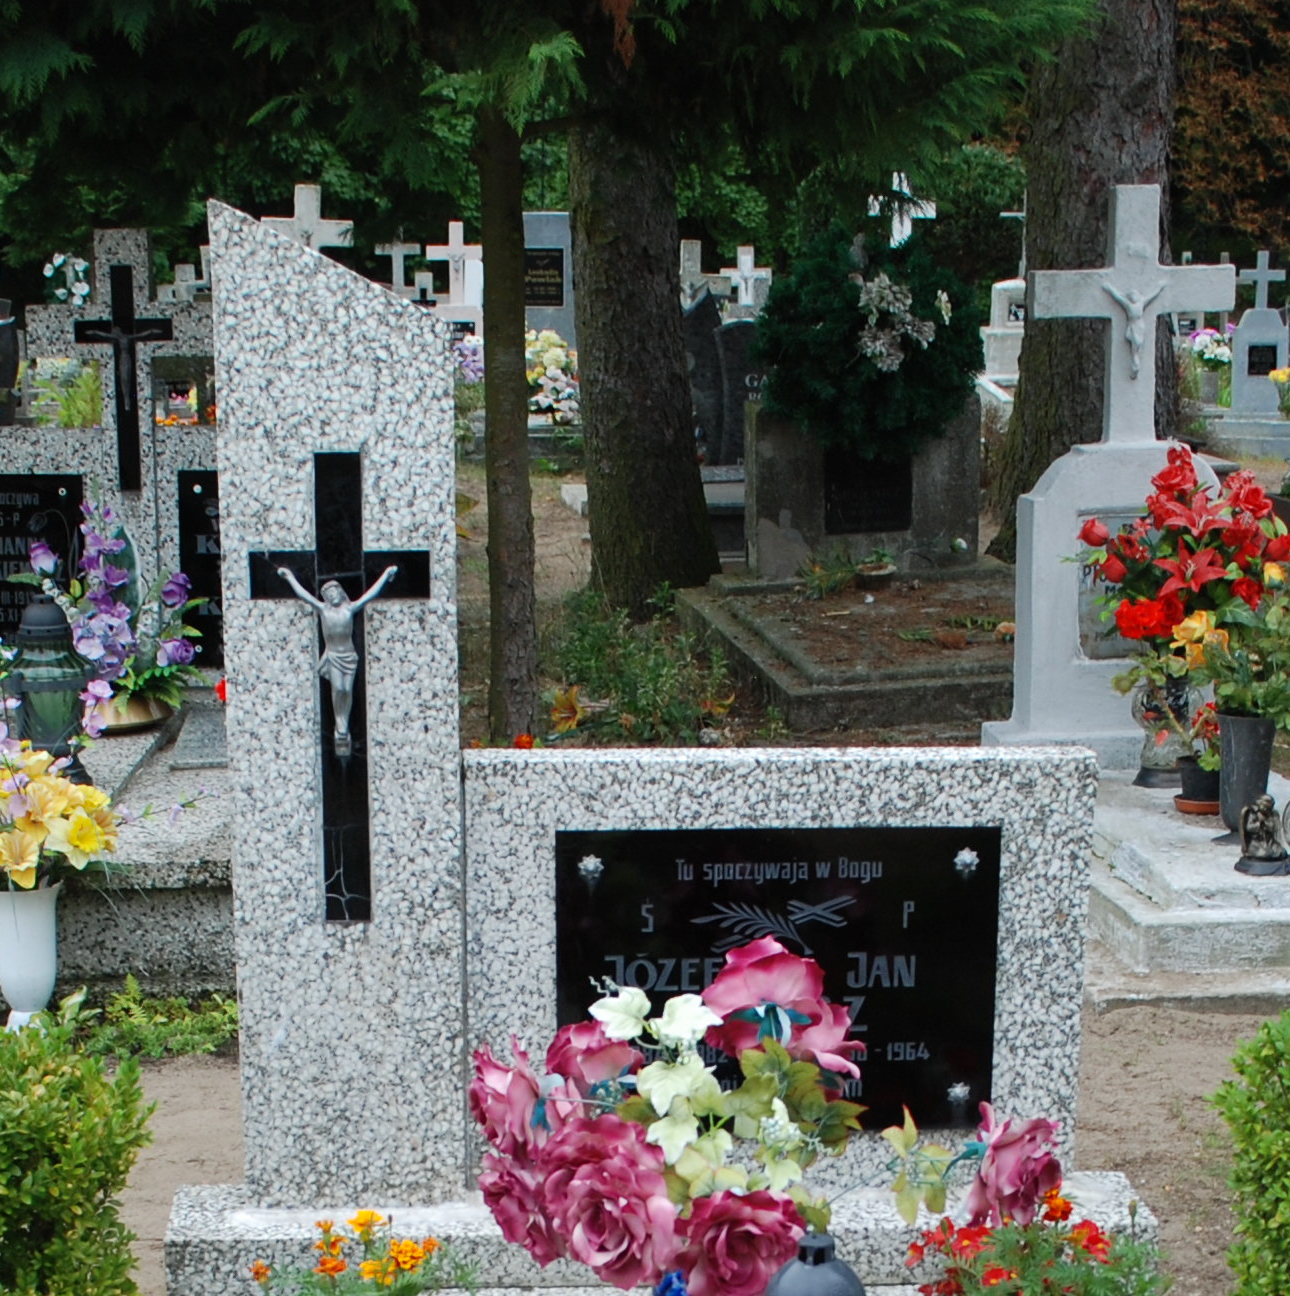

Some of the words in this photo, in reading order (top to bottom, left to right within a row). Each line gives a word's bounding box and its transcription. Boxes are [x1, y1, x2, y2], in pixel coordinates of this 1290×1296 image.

[675, 858, 694, 882] Tu
[702, 858, 809, 887] spoczywają
[815, 862, 831, 880] w
[837, 856, 883, 884] Bogu
[902, 900, 915, 929] P
[846, 951, 917, 989] JAN
[886, 1041, 931, 1061] 1964
